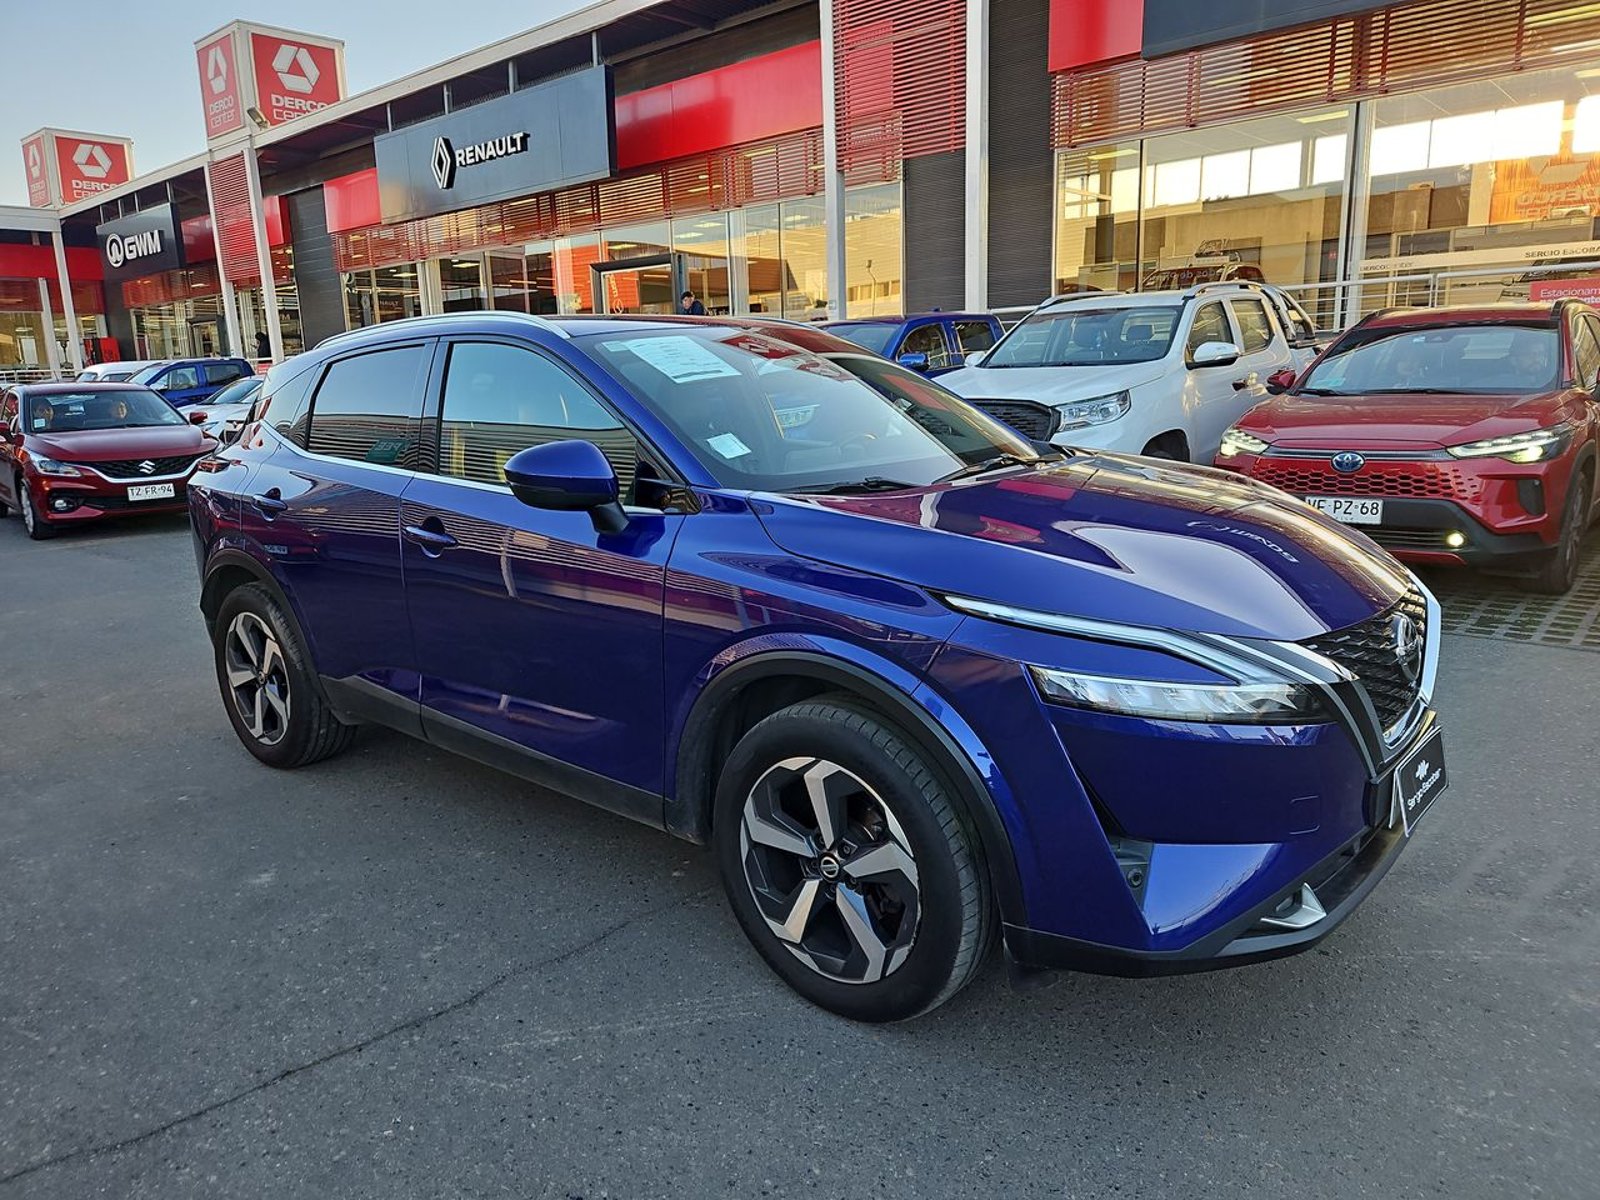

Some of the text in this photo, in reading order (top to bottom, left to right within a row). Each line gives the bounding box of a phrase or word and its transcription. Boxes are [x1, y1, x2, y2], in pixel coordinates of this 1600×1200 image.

[455, 132, 525, 167] RENAULT
[124, 229, 162, 260] GWM
[1525, 249, 1561, 258] SERGIO
[1360, 502, 1380, 516] 68
